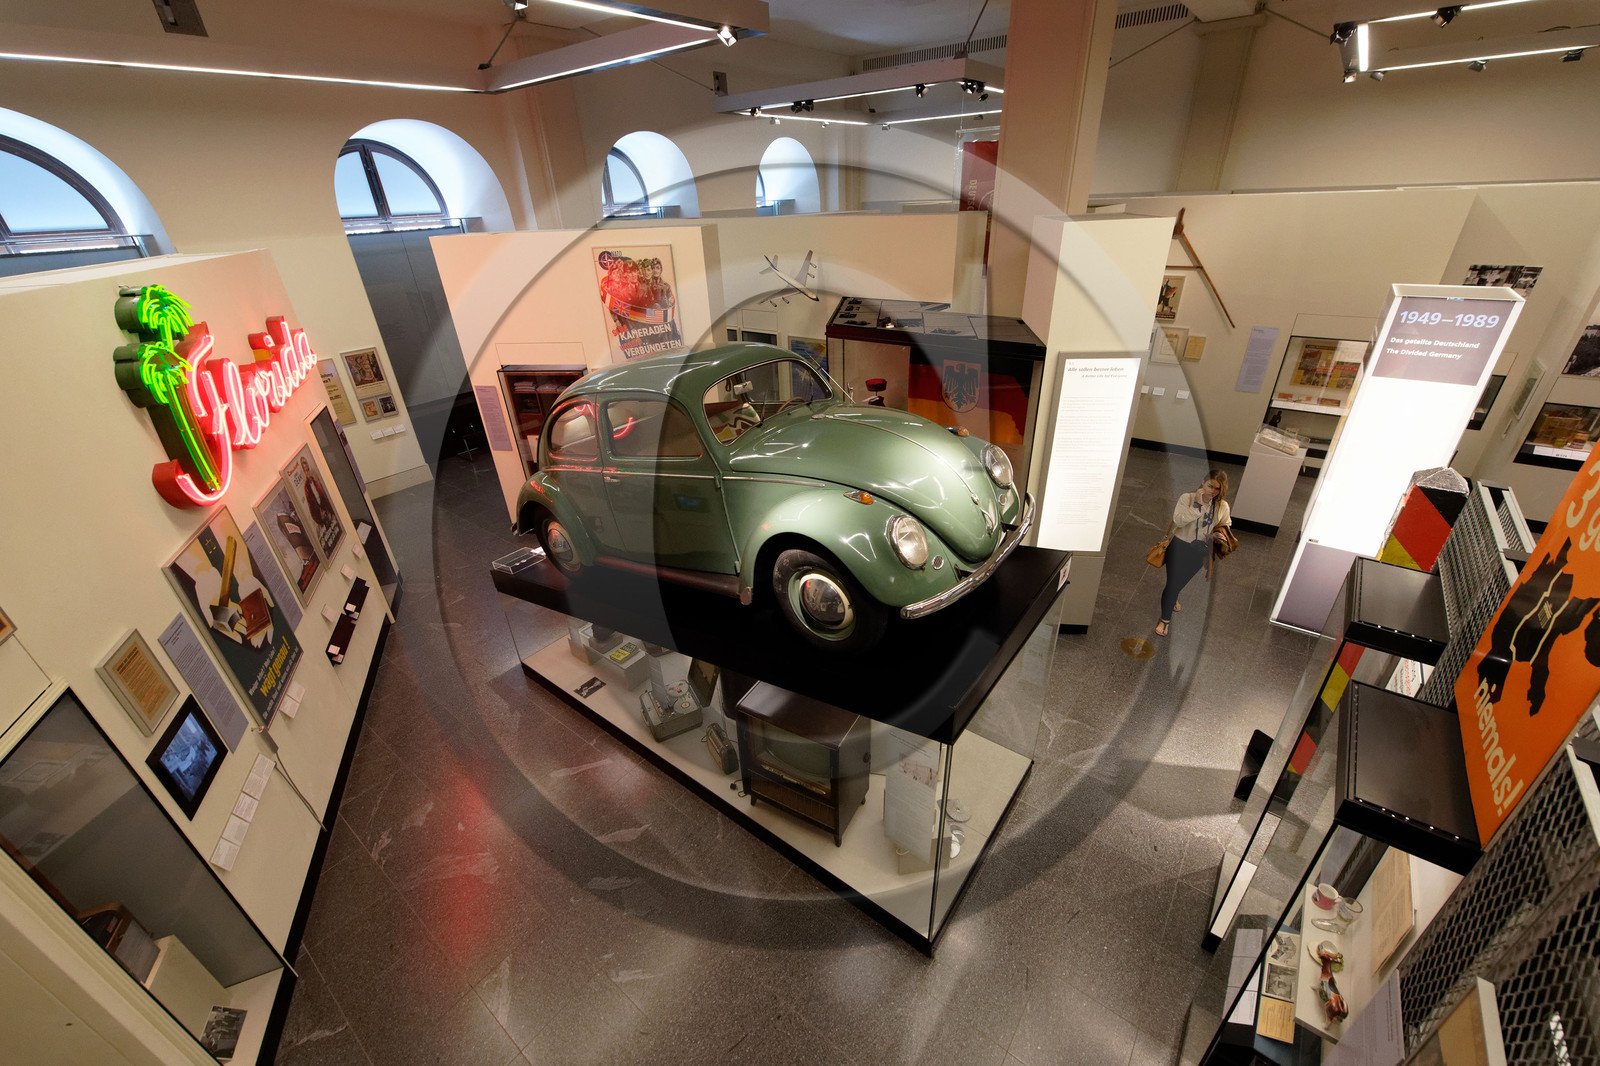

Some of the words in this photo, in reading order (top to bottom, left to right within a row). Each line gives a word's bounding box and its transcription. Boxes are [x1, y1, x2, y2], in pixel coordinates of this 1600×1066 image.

[620, 323, 671, 340] KAMERADEN
[1390, 336, 1404, 344] Das
[1404, 338, 1433, 347] geteilte
[1433, 340, 1481, 349] Deutschland
[625, 340, 682, 357] VERBÜNDETEN
[1386, 347, 1399, 355] The
[1400, 348, 1428, 357] Divided
[1428, 351, 1463, 361] Germany
[158, 318, 318, 506] Florida
[1566, 460, 1600, 529] 3
[259, 666, 277, 697] wägt
[1473, 677, 1524, 817] niemals!
